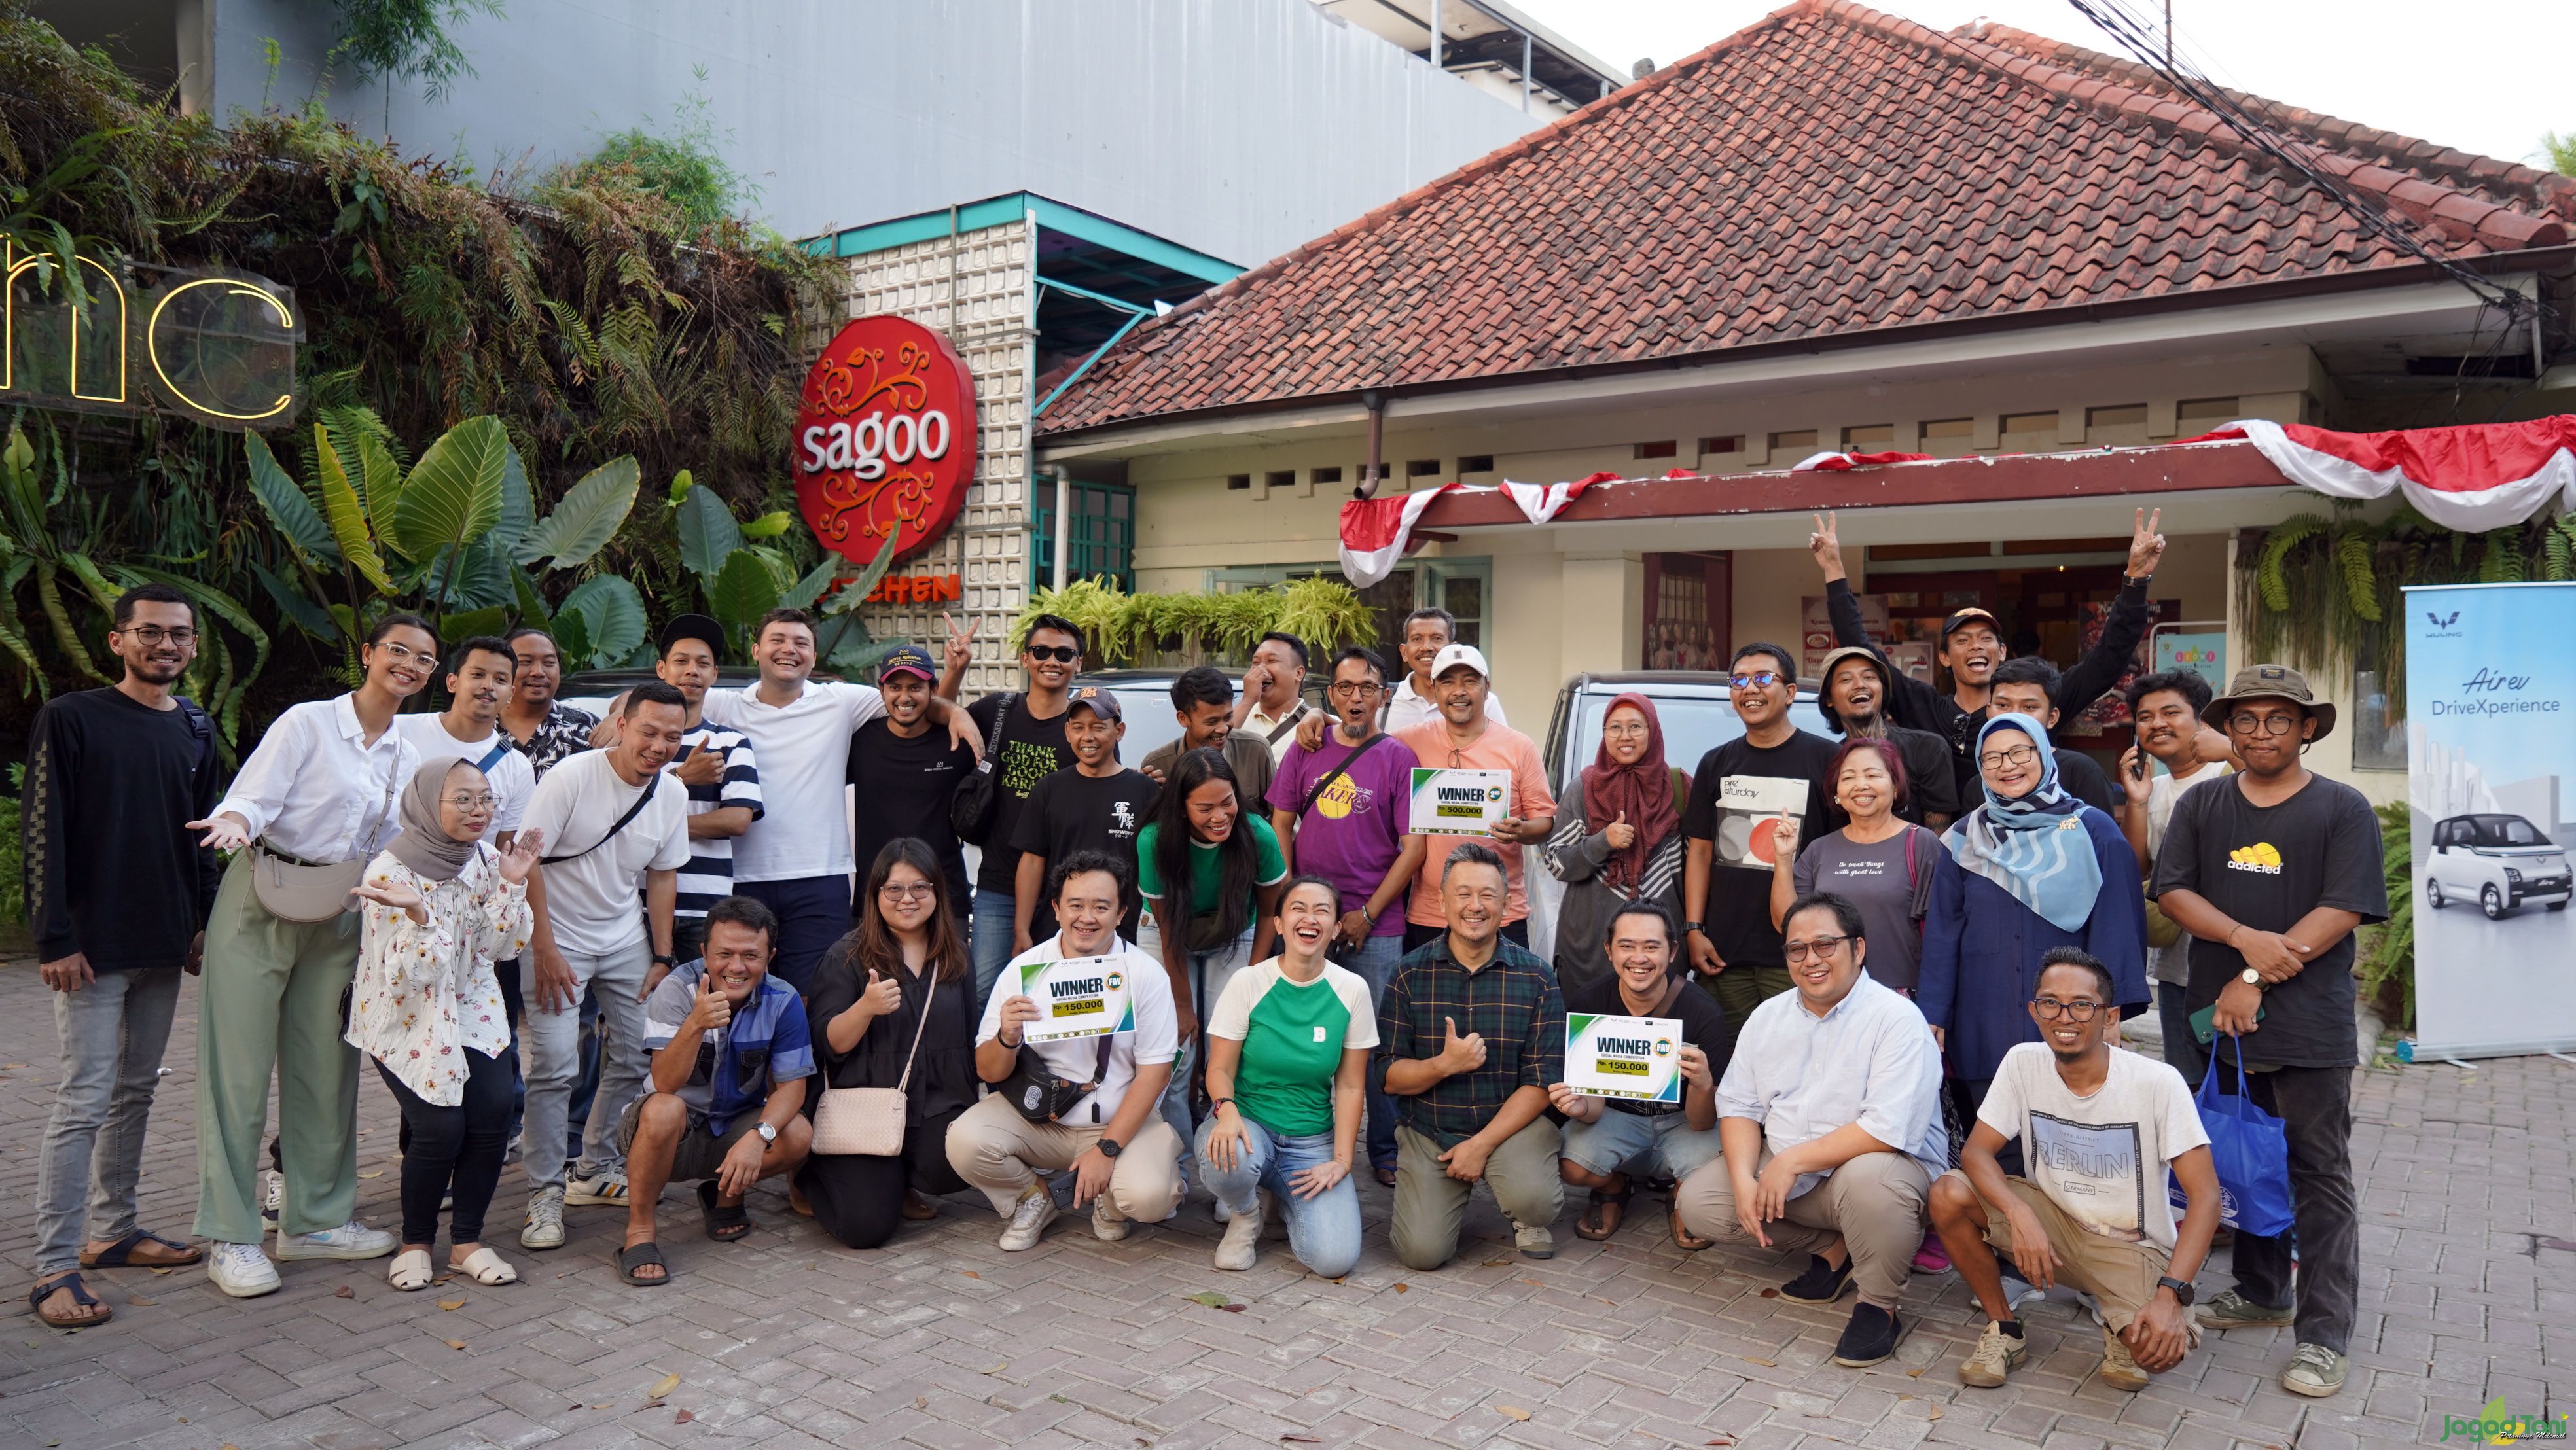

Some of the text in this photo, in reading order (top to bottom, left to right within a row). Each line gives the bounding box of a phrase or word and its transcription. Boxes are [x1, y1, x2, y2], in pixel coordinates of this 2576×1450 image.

[803, 410, 950, 481] sagoo
[2176, 652, 2214, 662] LEONI
[2432, 698, 2560, 718] DriveXperience
[1009, 739, 1057, 759] THANK
[1001, 751, 1059, 771] GOD FOR
[1724, 779, 1739, 788] pre
[1437, 787, 1484, 802] WINNER
[2227, 860, 2281, 875] addicted
[1050, 977, 1121, 998] WINNER FAV
[1064, 1000, 1103, 1011] 150.000
[1312, 1026, 1326, 1042] B
[1597, 1036, 1670, 1055] WINNER FAV
[1608, 1061, 1648, 1071] 150.000
[2036, 1139, 2130, 1180] BERLIN
[2065, 1184, 2094, 1194] GERMANY
